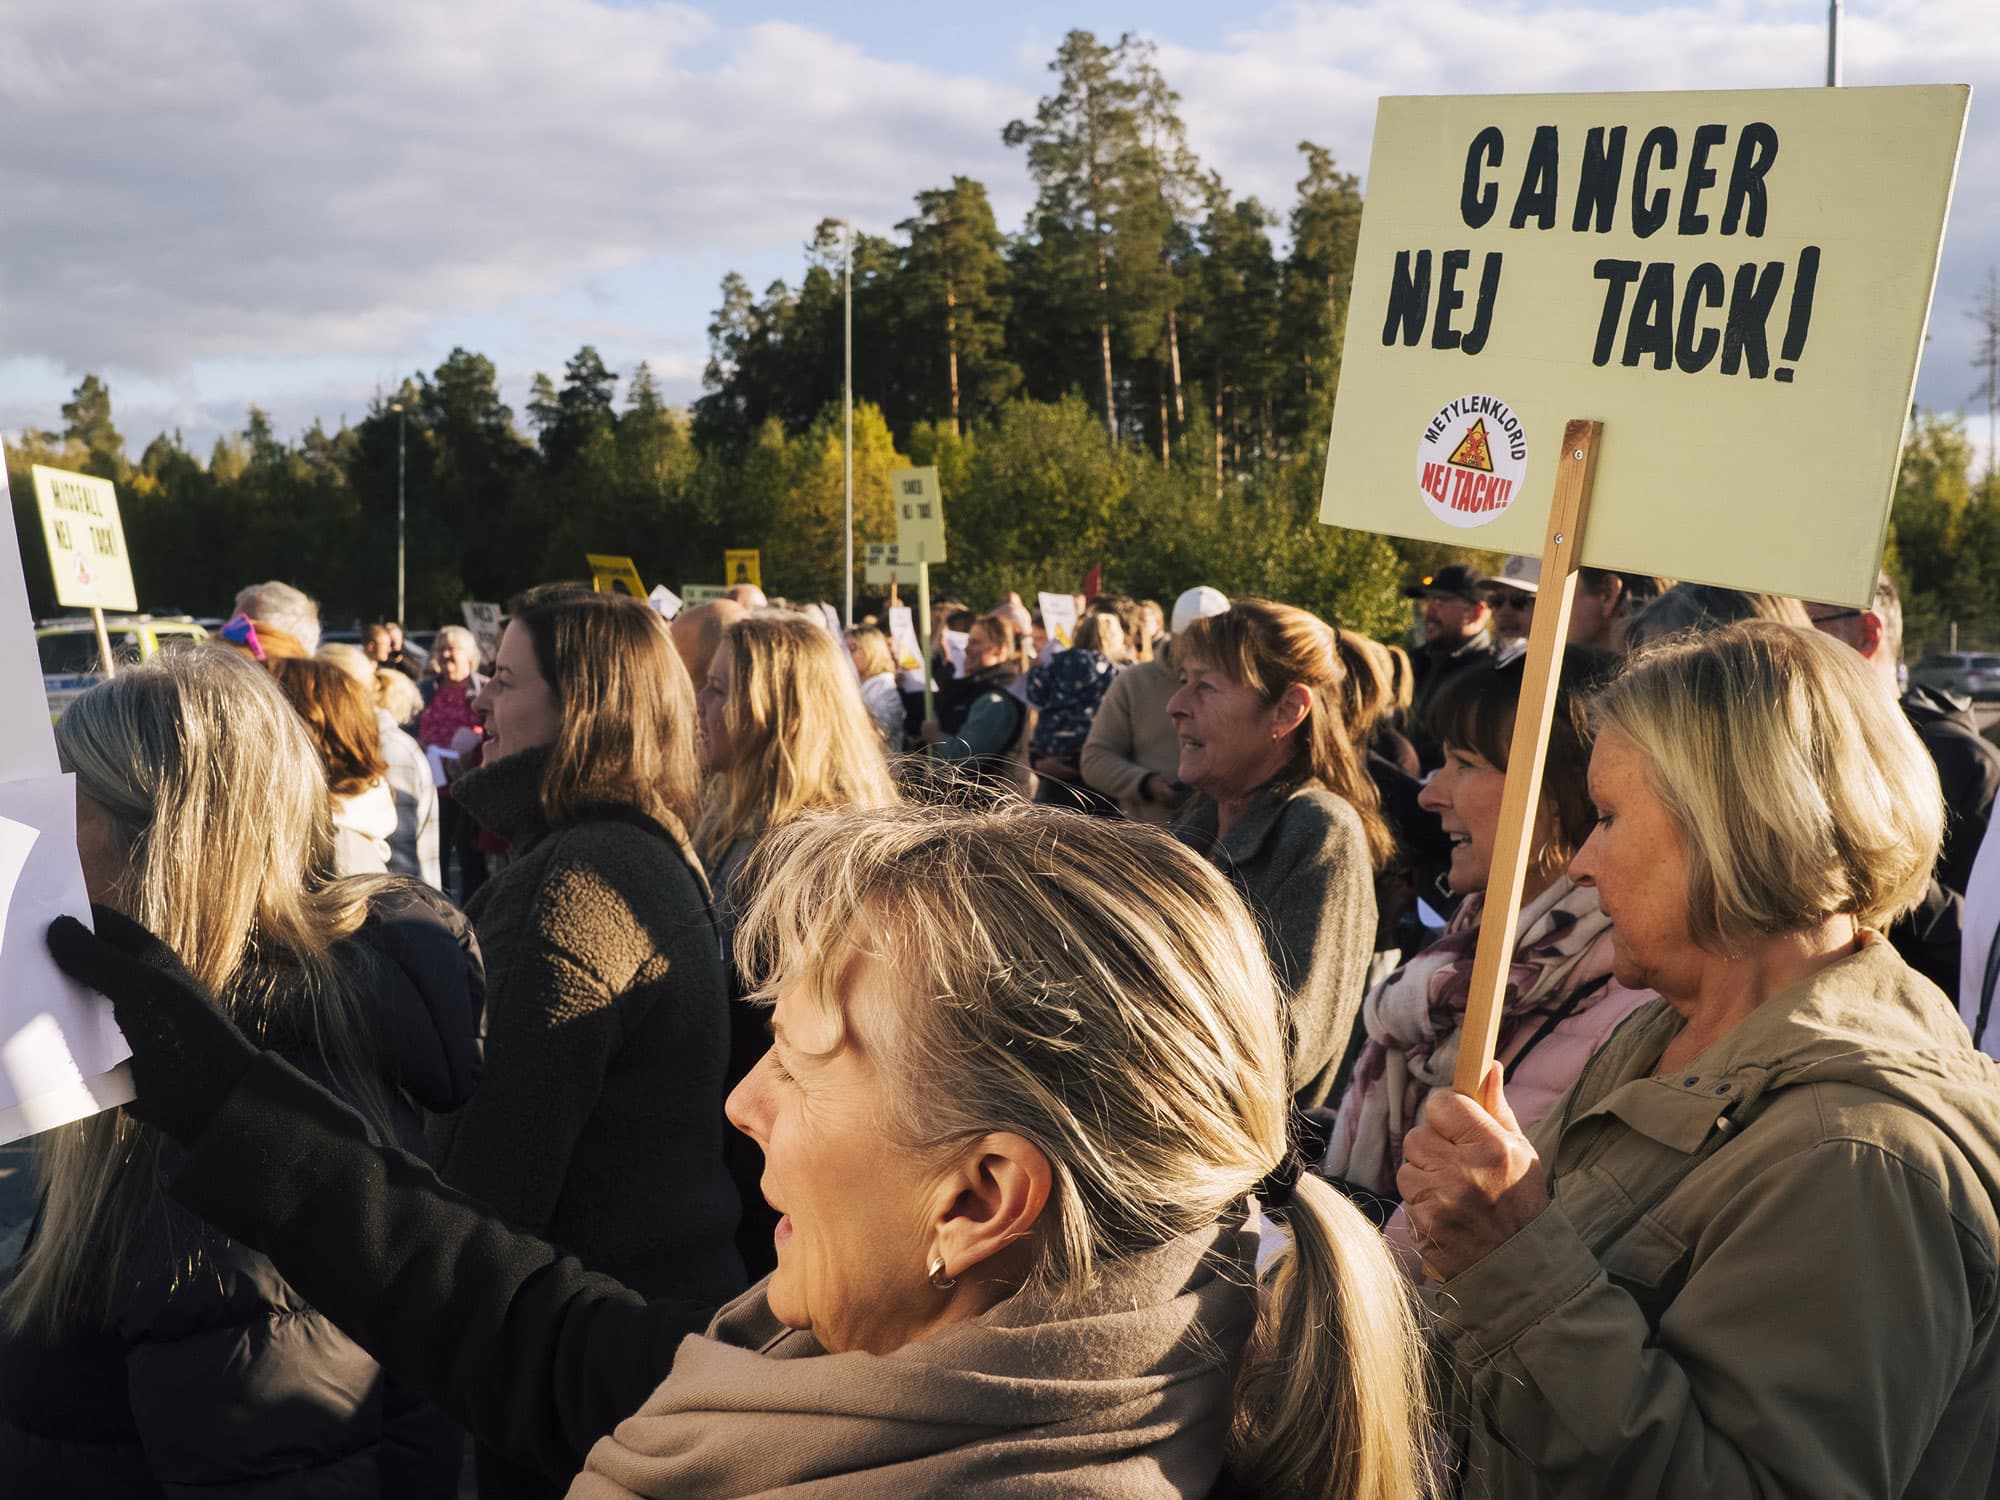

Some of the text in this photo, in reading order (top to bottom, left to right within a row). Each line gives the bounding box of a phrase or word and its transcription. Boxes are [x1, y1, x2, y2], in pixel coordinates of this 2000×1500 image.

[1461, 122, 1779, 238] CANCER
[1383, 246, 1820, 382] NEJ TACK!
[1424, 396, 1526, 461] METYLENKLORID
[1421, 462, 1512, 513] NEJ TACK!!
[53, 520, 72, 550] NEJ
